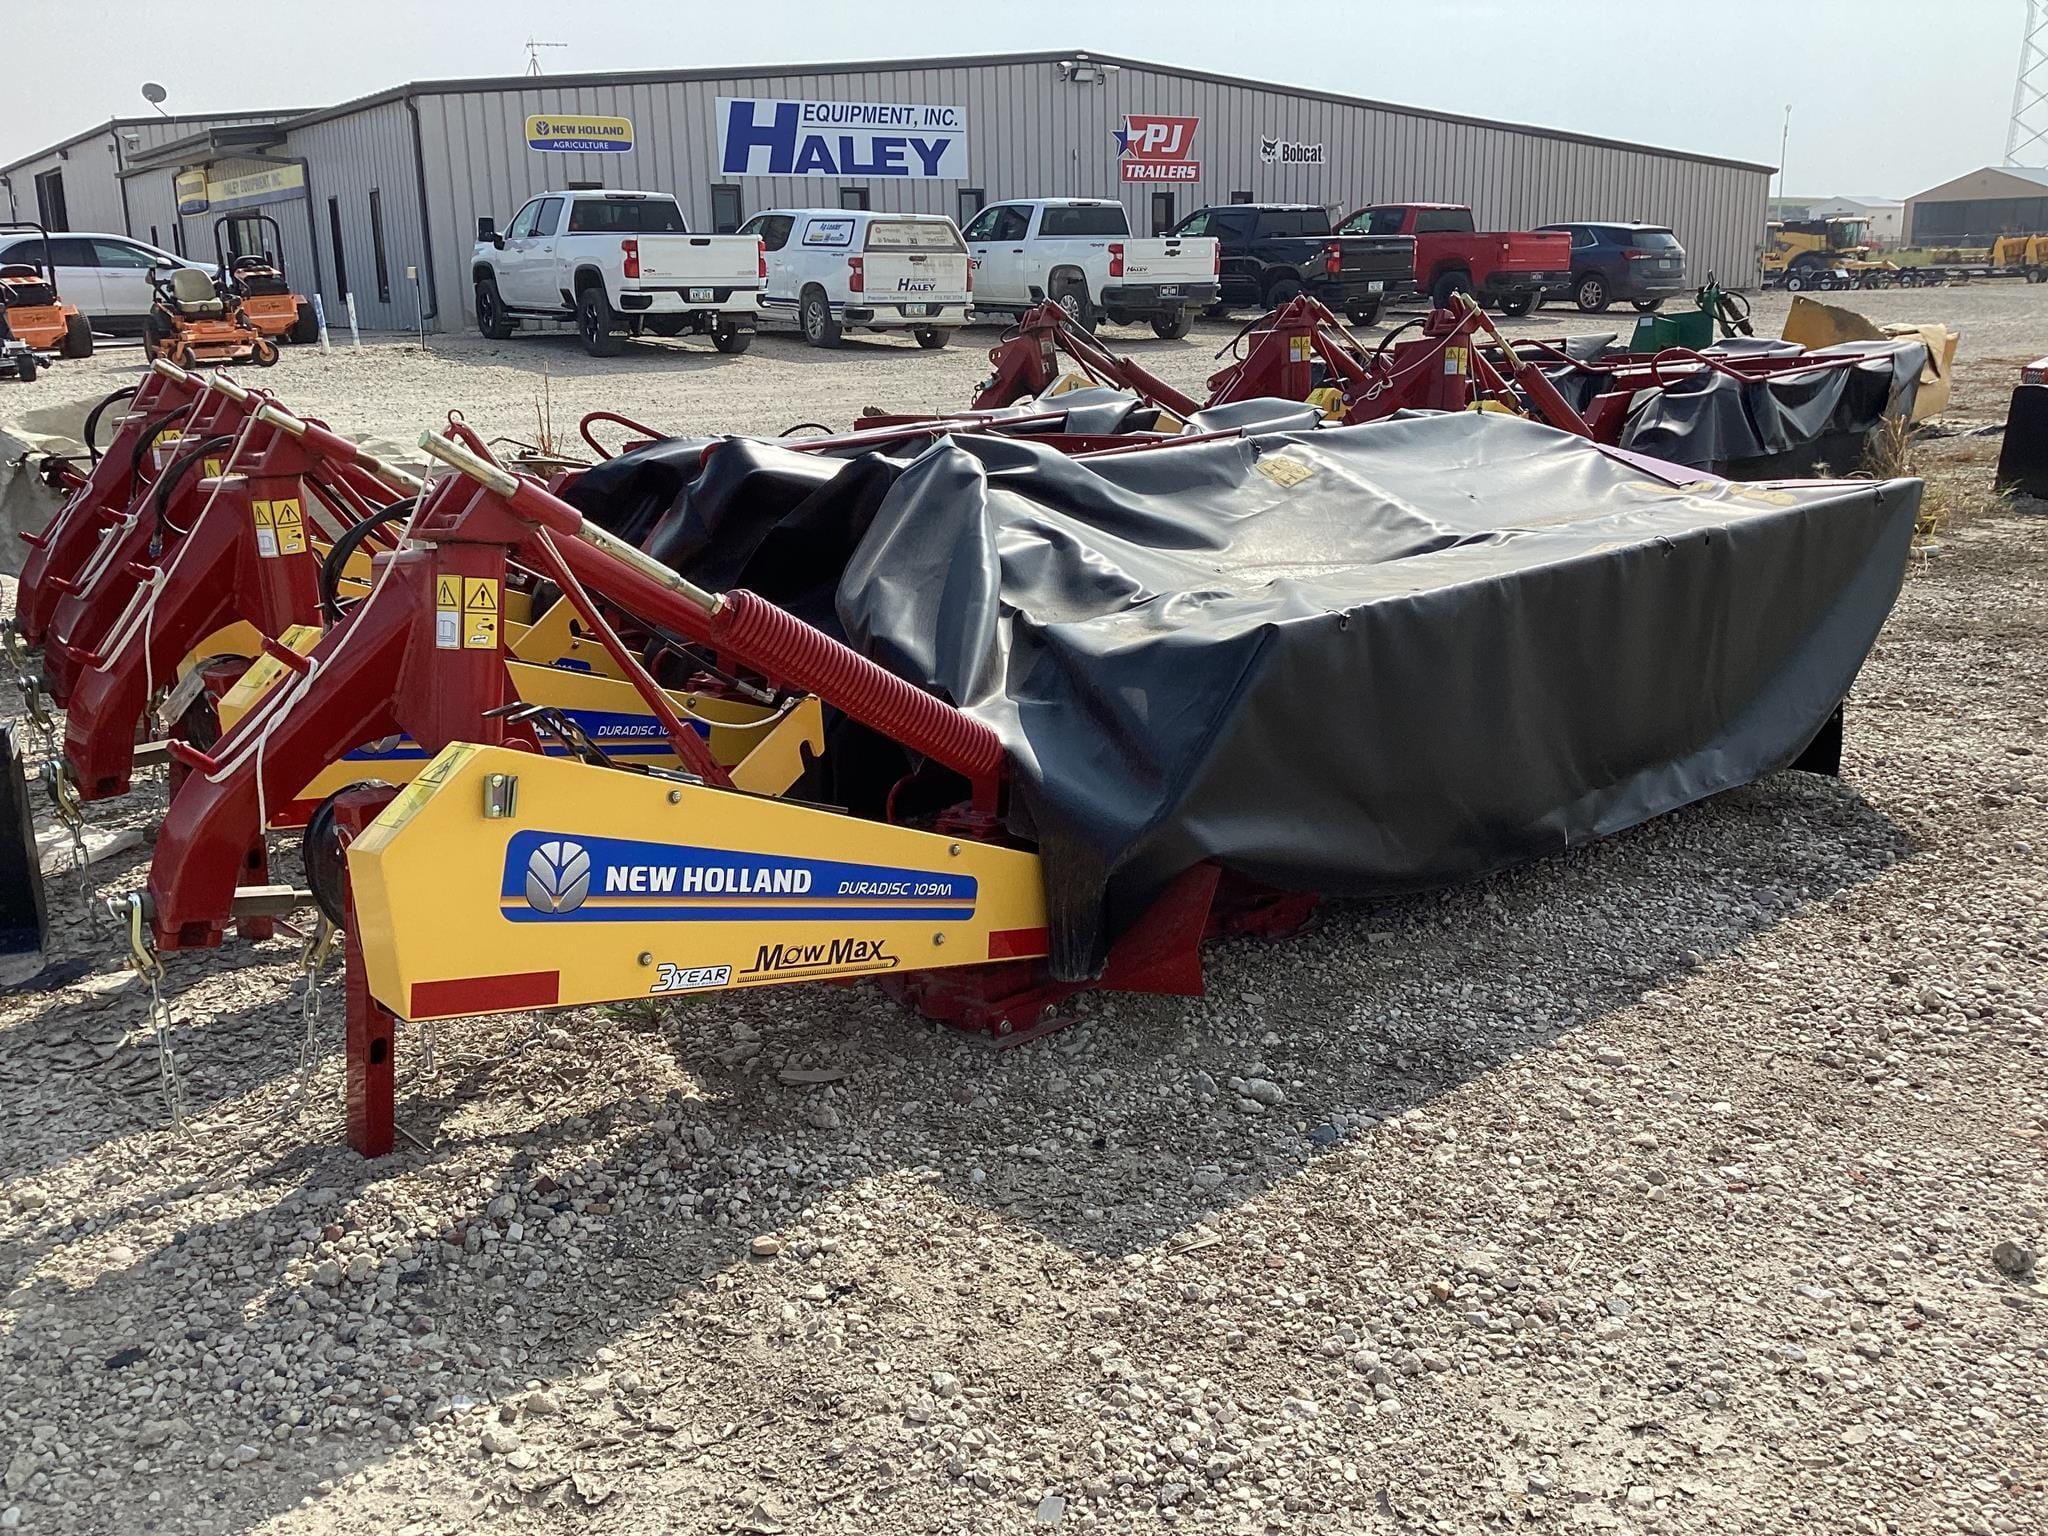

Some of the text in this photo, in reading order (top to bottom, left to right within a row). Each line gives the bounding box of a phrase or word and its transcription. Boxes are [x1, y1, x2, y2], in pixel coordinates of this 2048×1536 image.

[803, 103, 958, 128] EQUIPMENT, INC.
[552, 124, 624, 135] NEW HOLLAND
[723, 101, 951, 176] HALEY
[1142, 123, 1183, 153] PJ
[552, 141, 609, 149] AGRICULTURE
[1282, 143, 1322, 162] Bobcat
[1125, 164, 1197, 179] TRAILERS
[897, 278, 936, 291] HALEY
[597, 725, 656, 736] DURADISC
[605, 866, 952, 896] NEW HOLLAND DURADISC 109M
[755, 938, 885, 971] Mow Max
